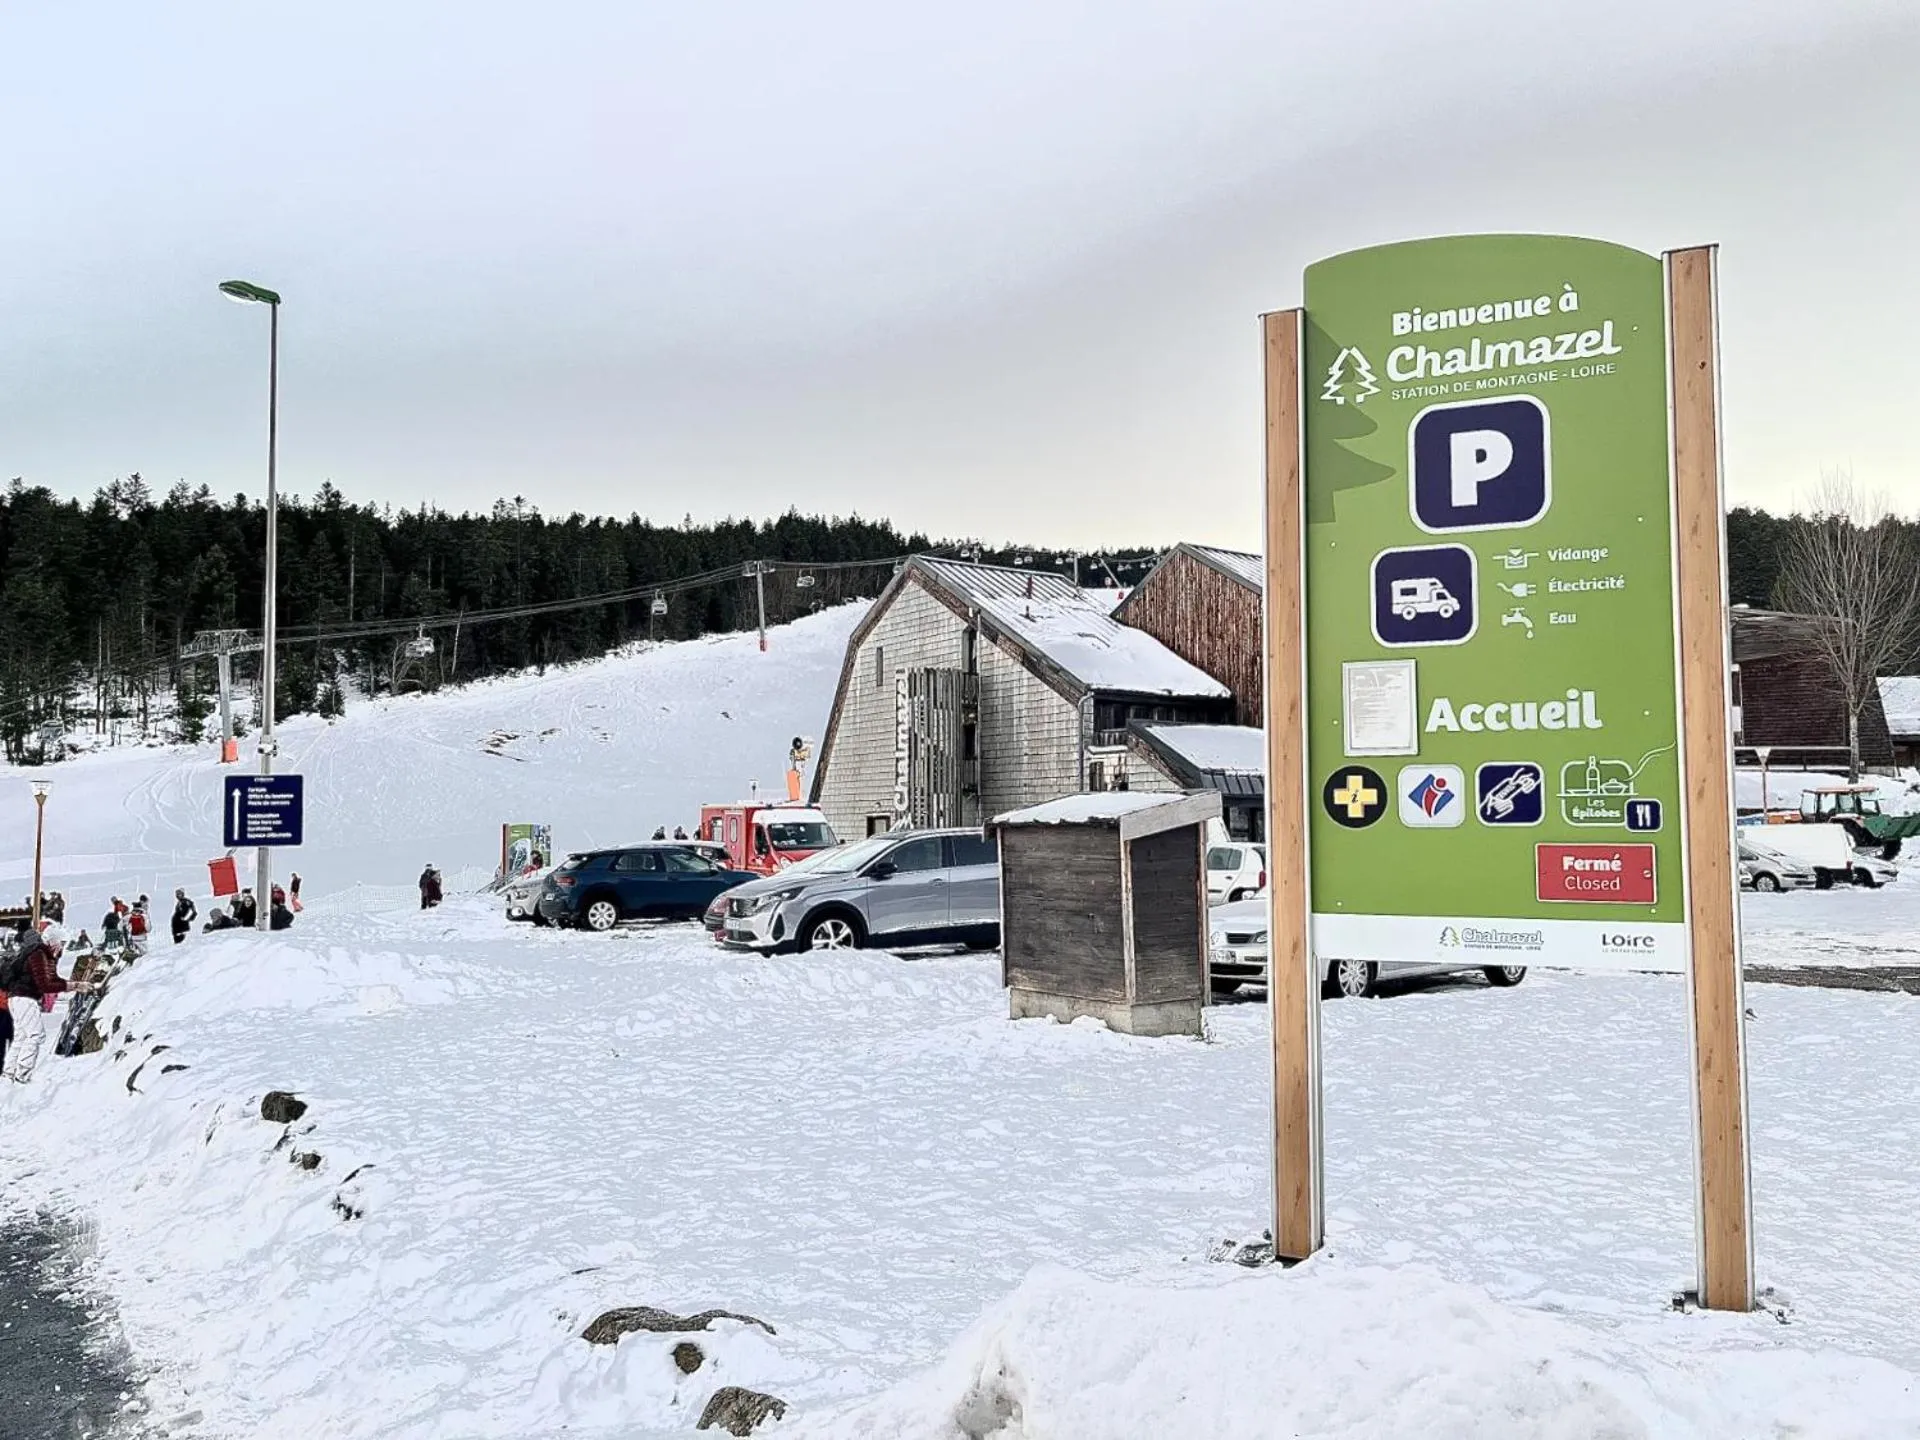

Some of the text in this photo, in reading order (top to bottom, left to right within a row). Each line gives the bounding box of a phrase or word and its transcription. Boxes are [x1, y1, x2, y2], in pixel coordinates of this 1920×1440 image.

[1392, 283, 1579, 336] Bienvenue à
[1386, 320, 1622, 382] Chalmazel
[1392, 383, 1449, 400] STATION
[1453, 380, 1471, 392] DE
[1476, 371, 1558, 390] MONTAGNE
[1571, 362, 1616, 378] LOIRE
[1450, 429, 1514, 508] P
[1547, 547, 1609, 562] Vidange
[1548, 574, 1625, 593] Électricité
[1549, 612, 1577, 624] Eau
[1424, 688, 1604, 732] Accueil
[1587, 798, 1605, 807] Les
[1572, 806, 1621, 820] Épilobes
[1562, 853, 1622, 871] Fermé
[1564, 876, 1621, 891] Closed
[1462, 927, 1544, 945] Chalmazel
